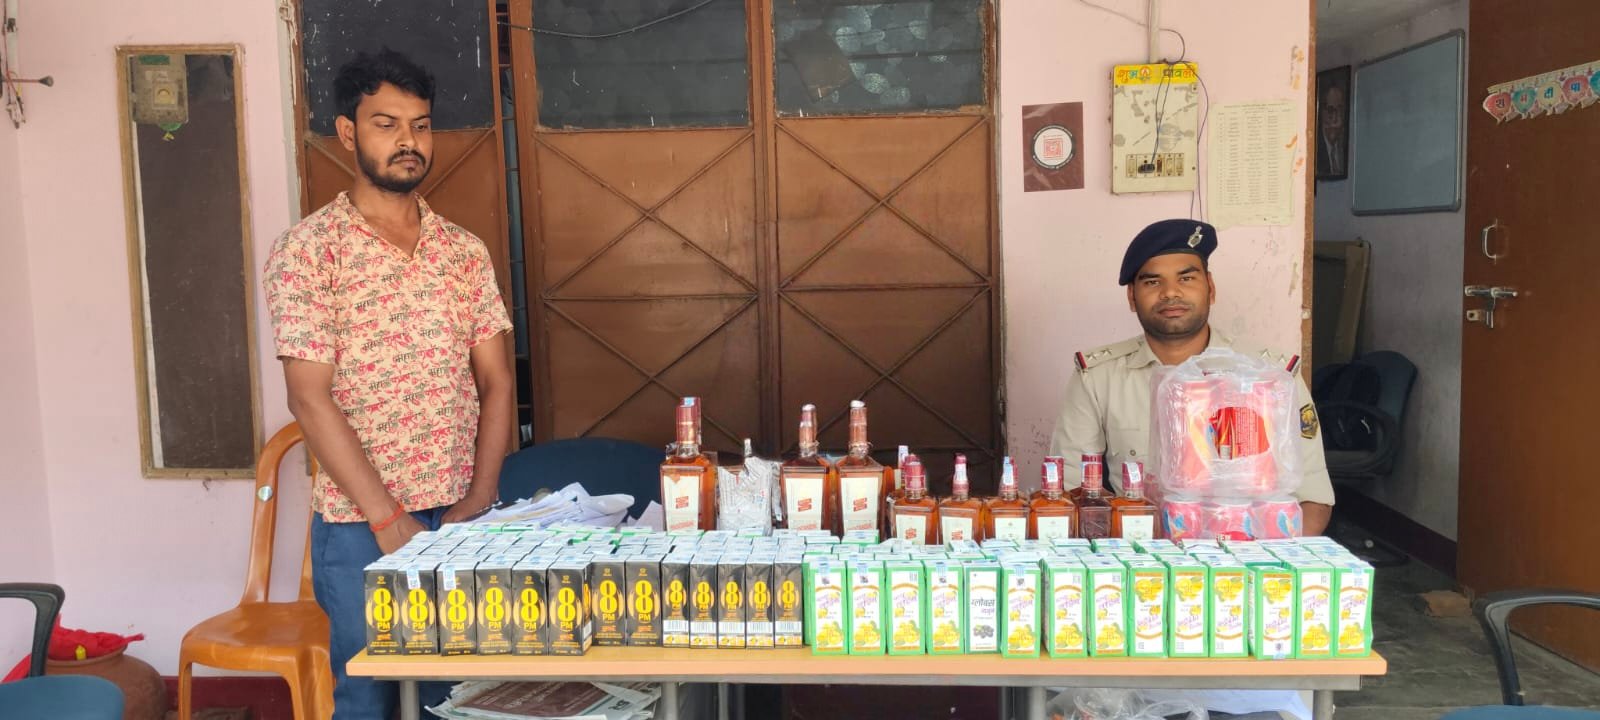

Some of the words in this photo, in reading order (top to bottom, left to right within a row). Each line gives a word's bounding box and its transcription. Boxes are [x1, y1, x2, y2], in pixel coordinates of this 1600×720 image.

[373, 588, 392, 622] 8
[485, 587, 504, 622] 8
[557, 588, 576, 622] 8
[599, 580, 618, 614] 8
[635, 580, 653, 614] 8
[669, 580, 683, 605] 8
[697, 581, 710, 606] 8
[726, 581, 739, 606] 8
[754, 581, 767, 605] 8
[782, 580, 795, 605] 8
[408, 588, 428, 623] 8
[447, 589, 467, 624] 8
[520, 588, 540, 623] 8
[602, 613, 616, 621] PM
[638, 613, 651, 621] PM
[377, 621, 391, 630] PM
[412, 621, 426, 630] PM
[451, 622, 465, 631] PM
[488, 621, 502, 629] PM
[523, 621, 537, 630] PM
[560, 621, 574, 629] PM
